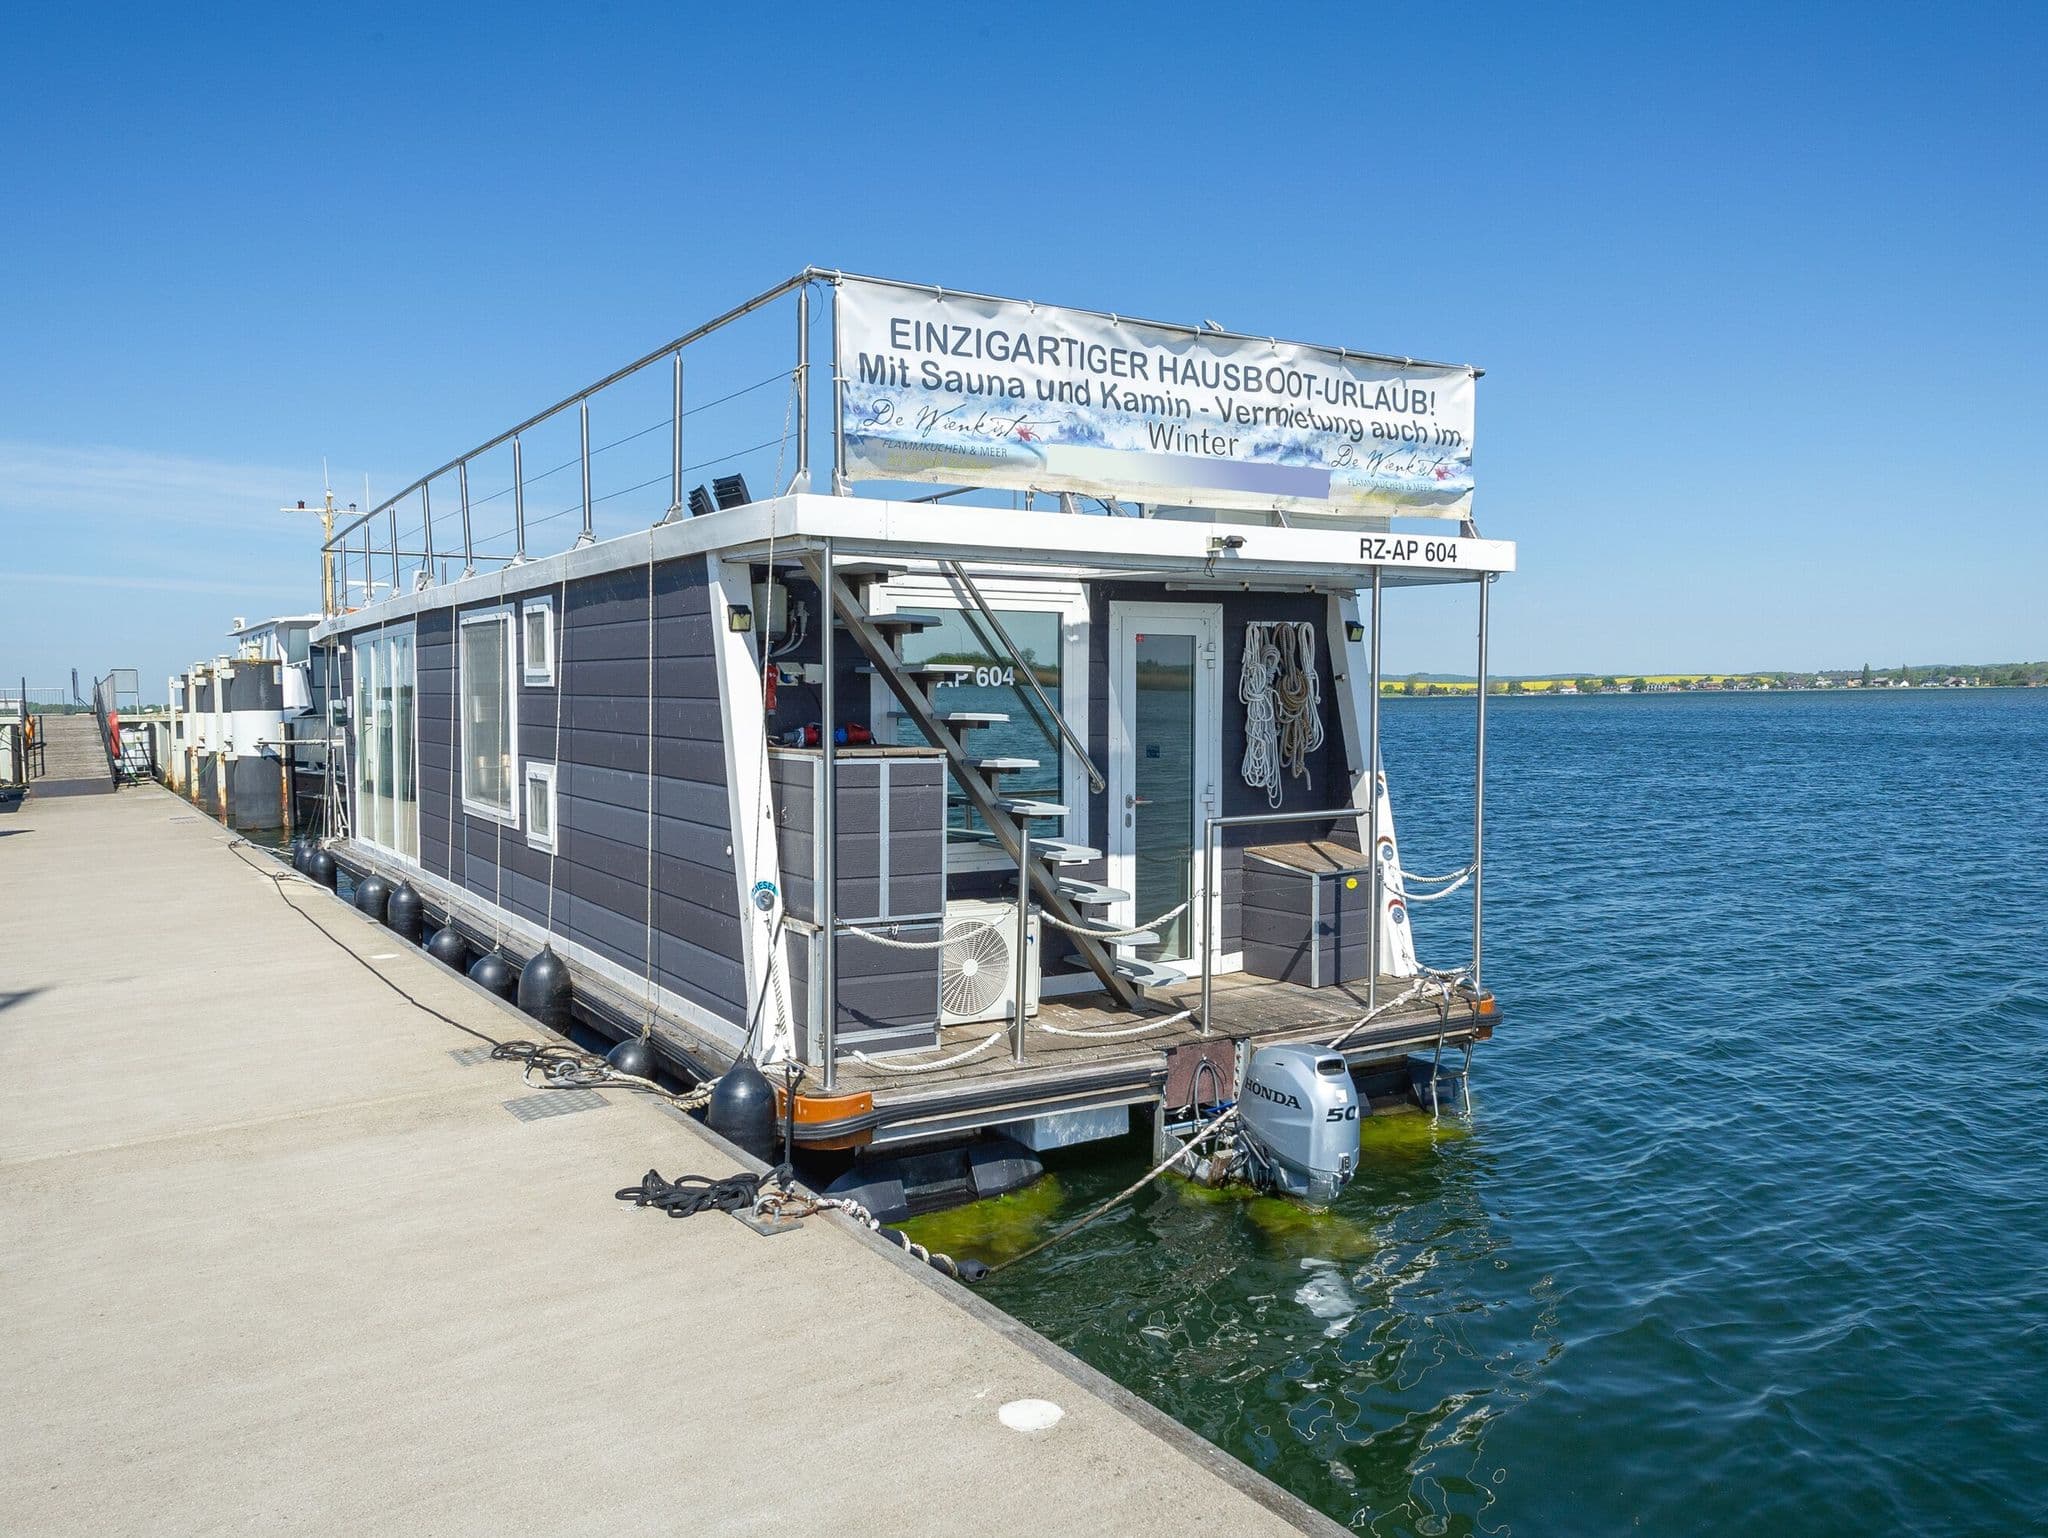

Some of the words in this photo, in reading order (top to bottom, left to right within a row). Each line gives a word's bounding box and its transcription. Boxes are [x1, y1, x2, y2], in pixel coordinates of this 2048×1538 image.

[890, 317, 1149, 381] EINZIGARTIGER
[1159, 354, 1436, 416] HAUSBOOT-URLAUB!
[858, 352, 911, 388] Mit
[921, 360, 1026, 399] Sauna
[1037, 377, 1090, 407] und
[1101, 381, 1191, 419] Kamin
[1214, 395, 1364, 442] Vermietung
[1371, 421, 1428, 445] auch
[1434, 429, 1462, 447] im
[863, 399, 905, 427] De
[979, 446, 1008, 458] MEER
[1149, 422, 1240, 456] Winter
[1331, 444, 1358, 468] De
[1360, 538, 1418, 562] RZ-AP
[1425, 541, 1458, 563] 604
[976, 666, 1015, 687] 604
[1244, 1077, 1302, 1110] HONDA
[1326, 1105, 1357, 1122] 50
